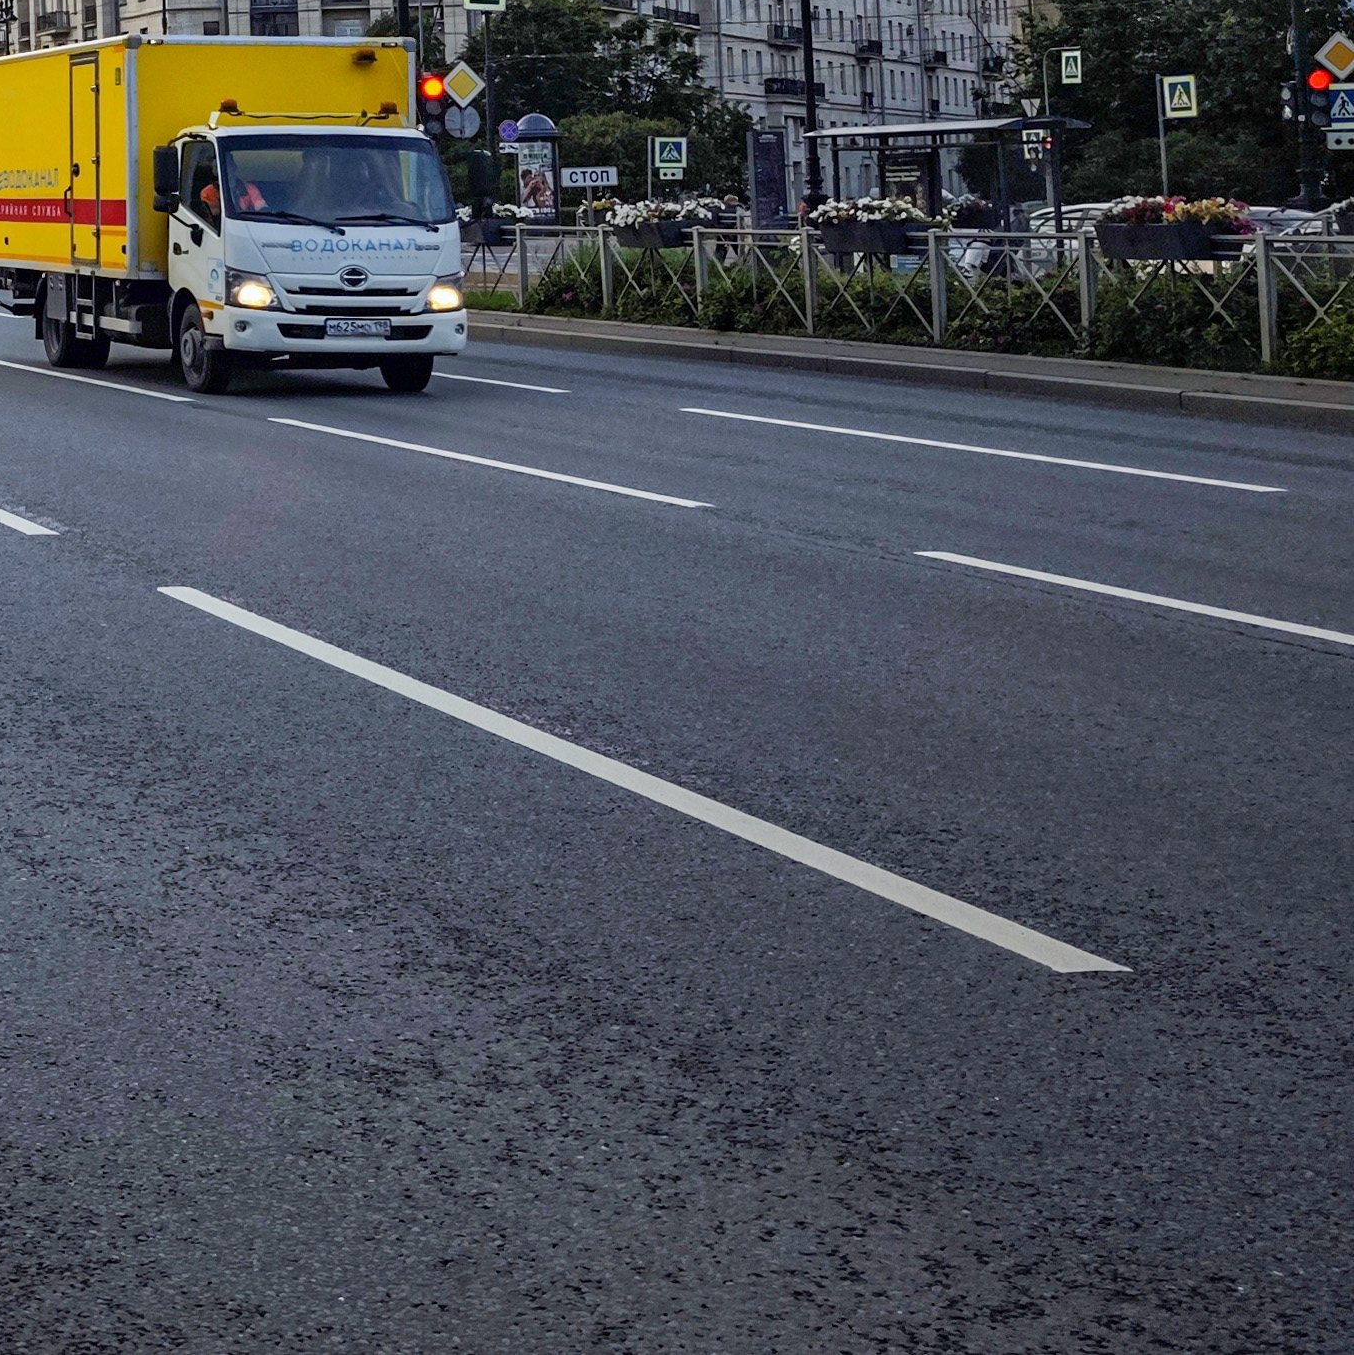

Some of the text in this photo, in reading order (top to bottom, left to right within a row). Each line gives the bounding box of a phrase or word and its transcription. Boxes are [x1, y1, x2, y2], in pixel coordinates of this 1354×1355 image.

[569, 170, 610, 184] СТОП
[32, 205, 62, 217] СЛУЖБА
[290, 238, 418, 254] ВОДОКАНАЛ
